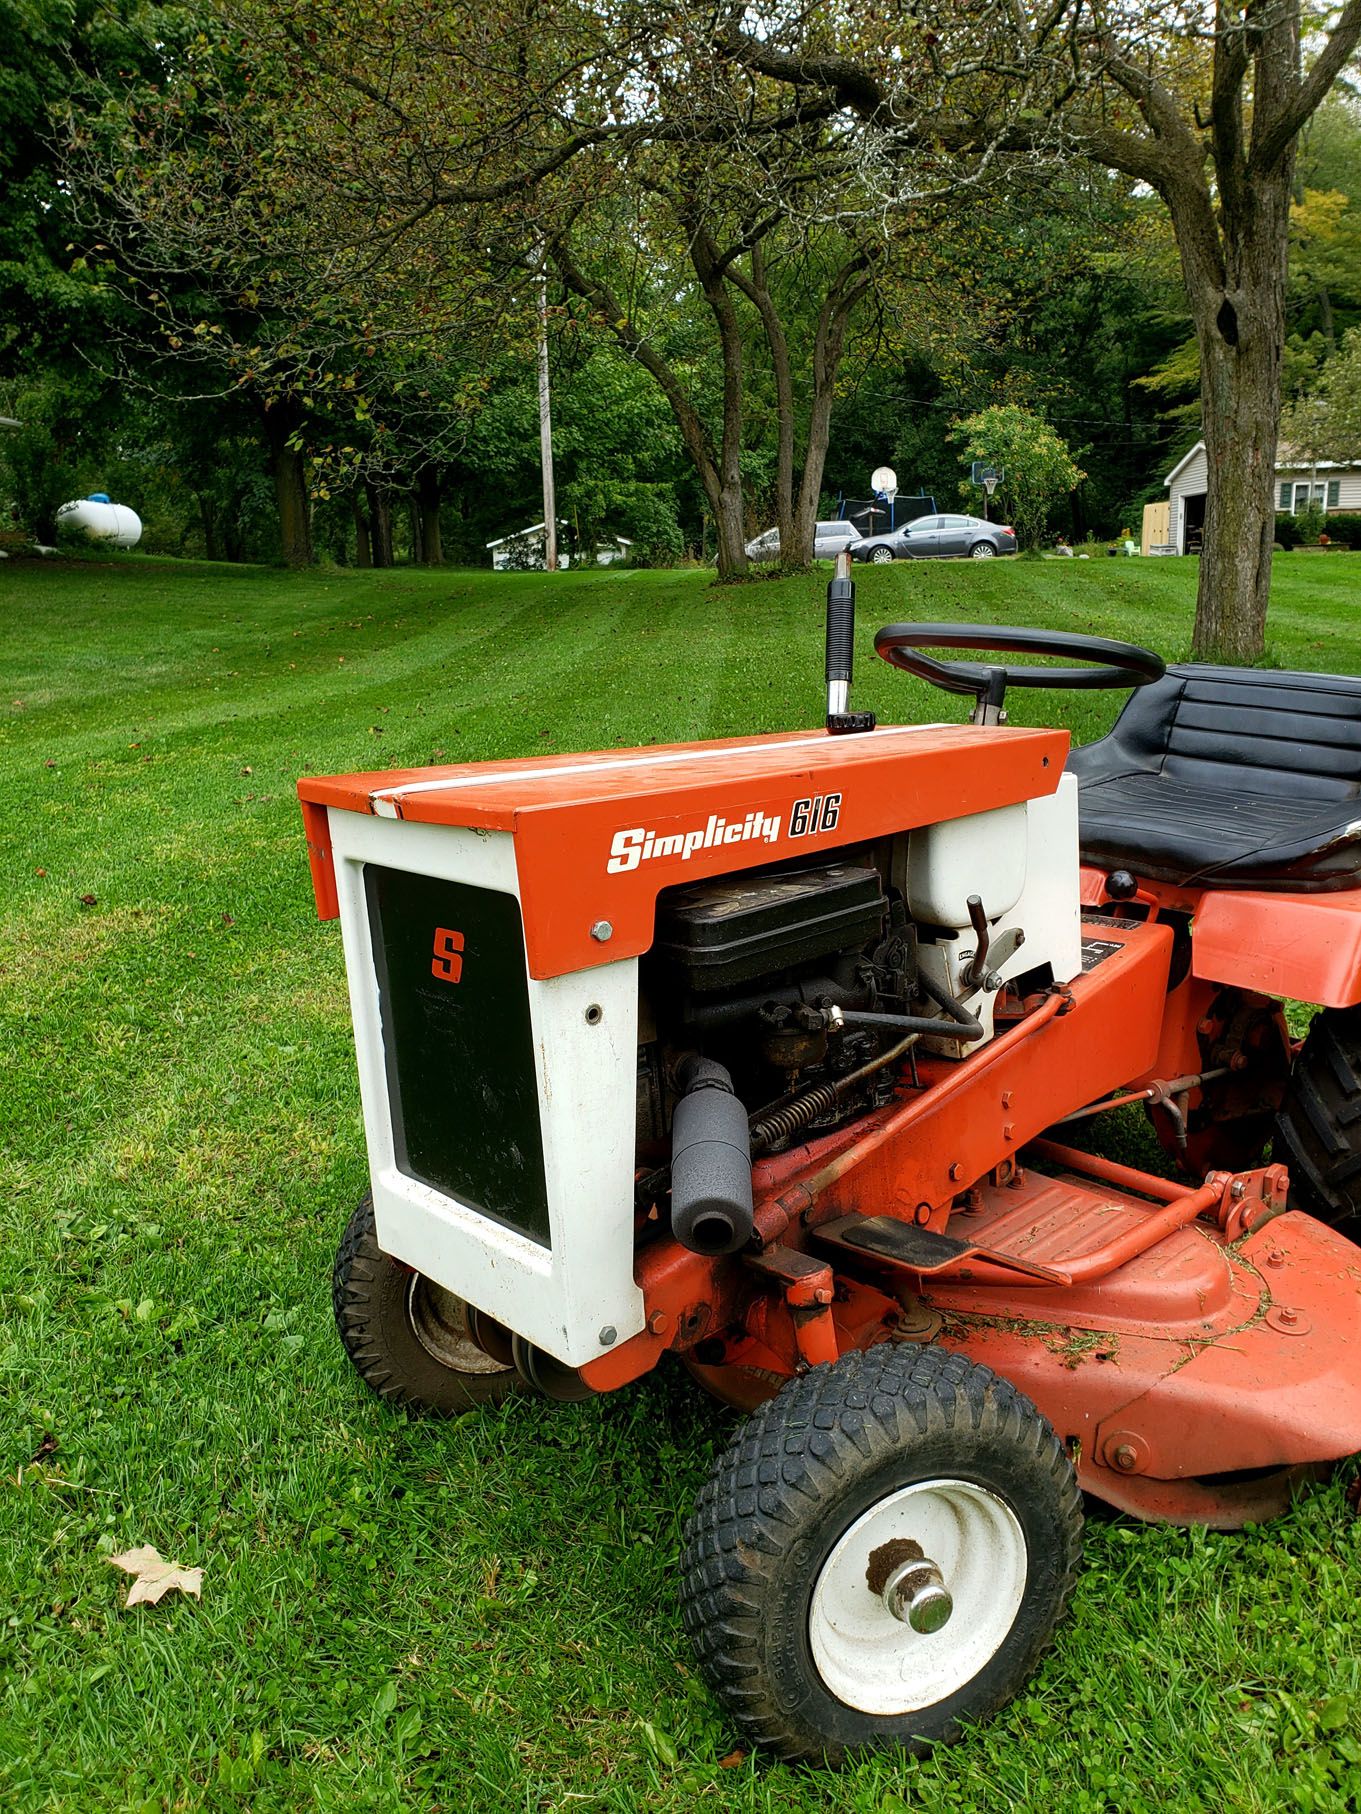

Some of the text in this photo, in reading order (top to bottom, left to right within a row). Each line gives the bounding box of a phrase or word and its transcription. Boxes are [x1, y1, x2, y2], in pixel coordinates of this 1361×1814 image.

[606, 793, 842, 874] Simplicity 616
[431, 927, 465, 984] S
